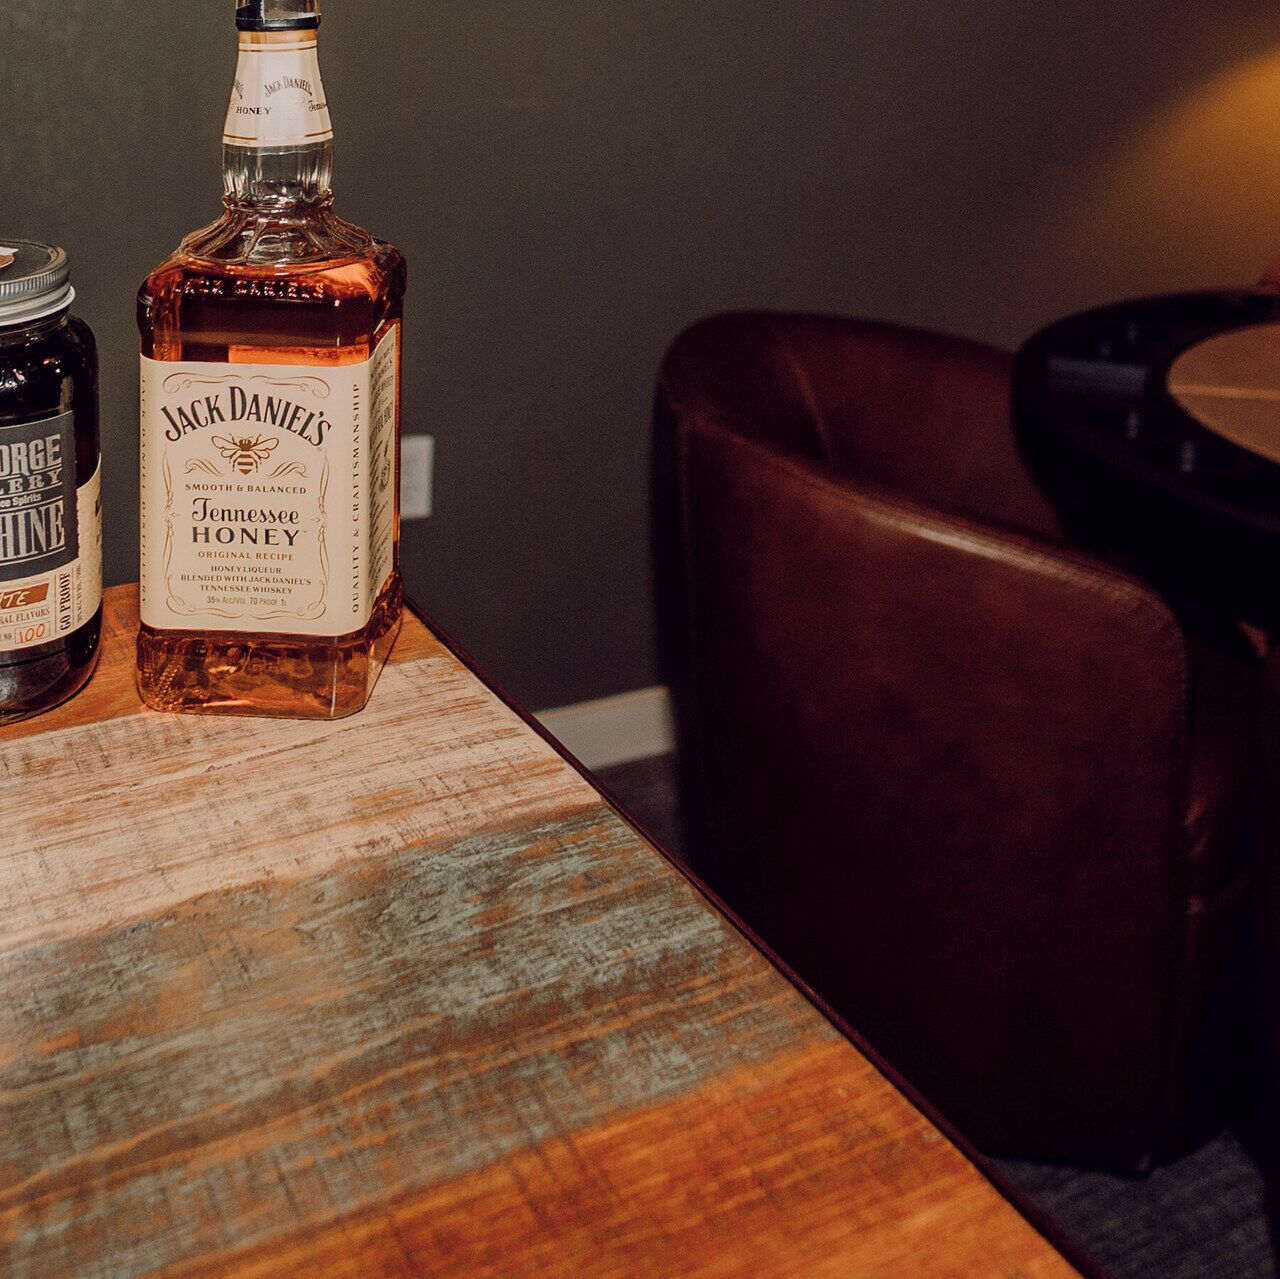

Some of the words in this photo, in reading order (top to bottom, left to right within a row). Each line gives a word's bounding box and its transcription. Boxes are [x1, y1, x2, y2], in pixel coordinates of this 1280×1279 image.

[236, 106, 270, 115] HONEY
[160, 394, 227, 442] JACK
[229, 385, 332, 447] DANIEL'S
[352, 384, 360, 522] CRAFTSMANSHIP
[185, 483, 233, 492] SMOOTH
[236, 484, 244, 492] &
[247, 484, 307, 495] BALANCED
[12, 493, 42, 506] Spirits
[191, 497, 301, 525] Tennessee
[192, 526, 300, 547] HONEY
[198, 550, 251, 560] ORIGINAL
[256, 552, 295, 561] RECIPE
[211, 565, 241, 573] HONEY
[243, 566, 282, 574] LIQUEUR
[181, 574, 222, 582] BLENDED
[272, 577, 312, 586] DANIEL'S
[352, 545, 360, 613] QUALITY
[60, 572, 71, 613] PROOF
[200, 584, 250, 593] TENNESSEE
[252, 586, 293, 595] WHISKEY
[16, 607, 51, 621] FLAVORS
[60, 614, 71, 630] 60
